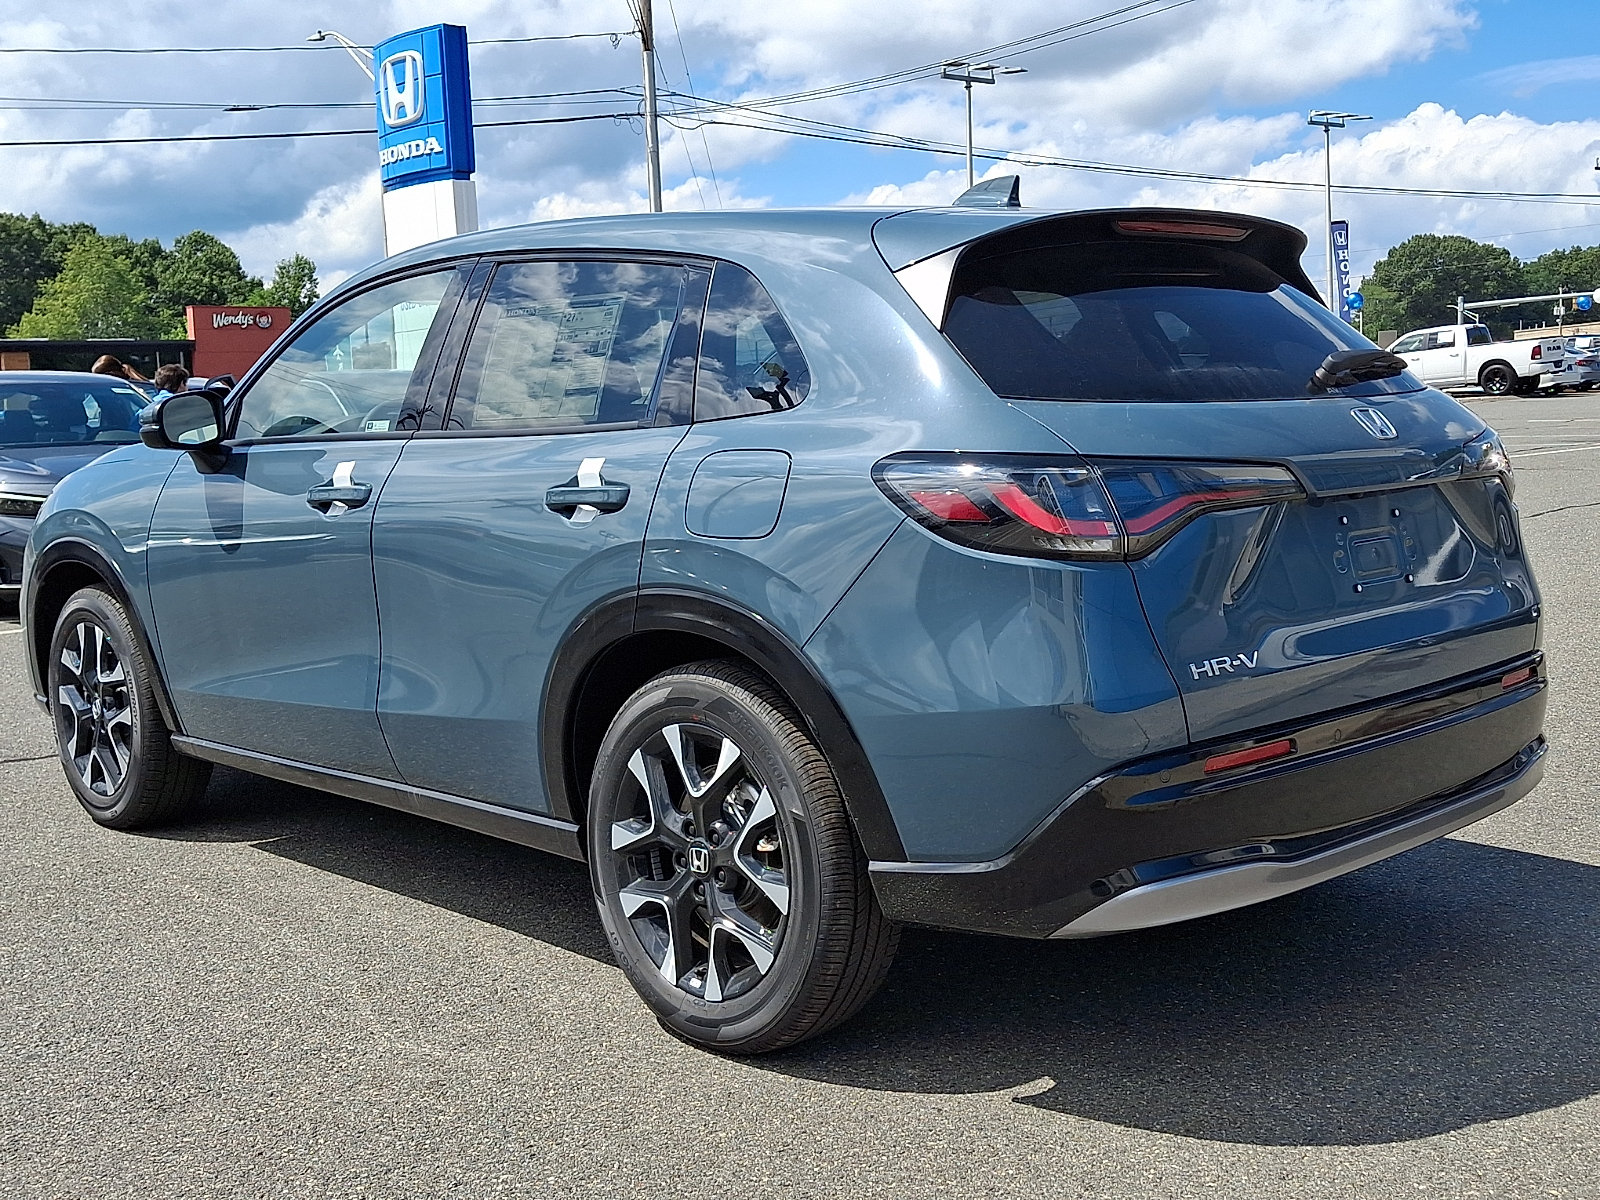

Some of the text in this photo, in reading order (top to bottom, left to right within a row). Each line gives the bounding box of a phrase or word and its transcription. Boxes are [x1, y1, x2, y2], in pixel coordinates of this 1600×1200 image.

[379, 137, 443, 167] HONDA
[213, 311, 254, 329] Wendy's
[1189, 650, 1258, 680] HR-V
